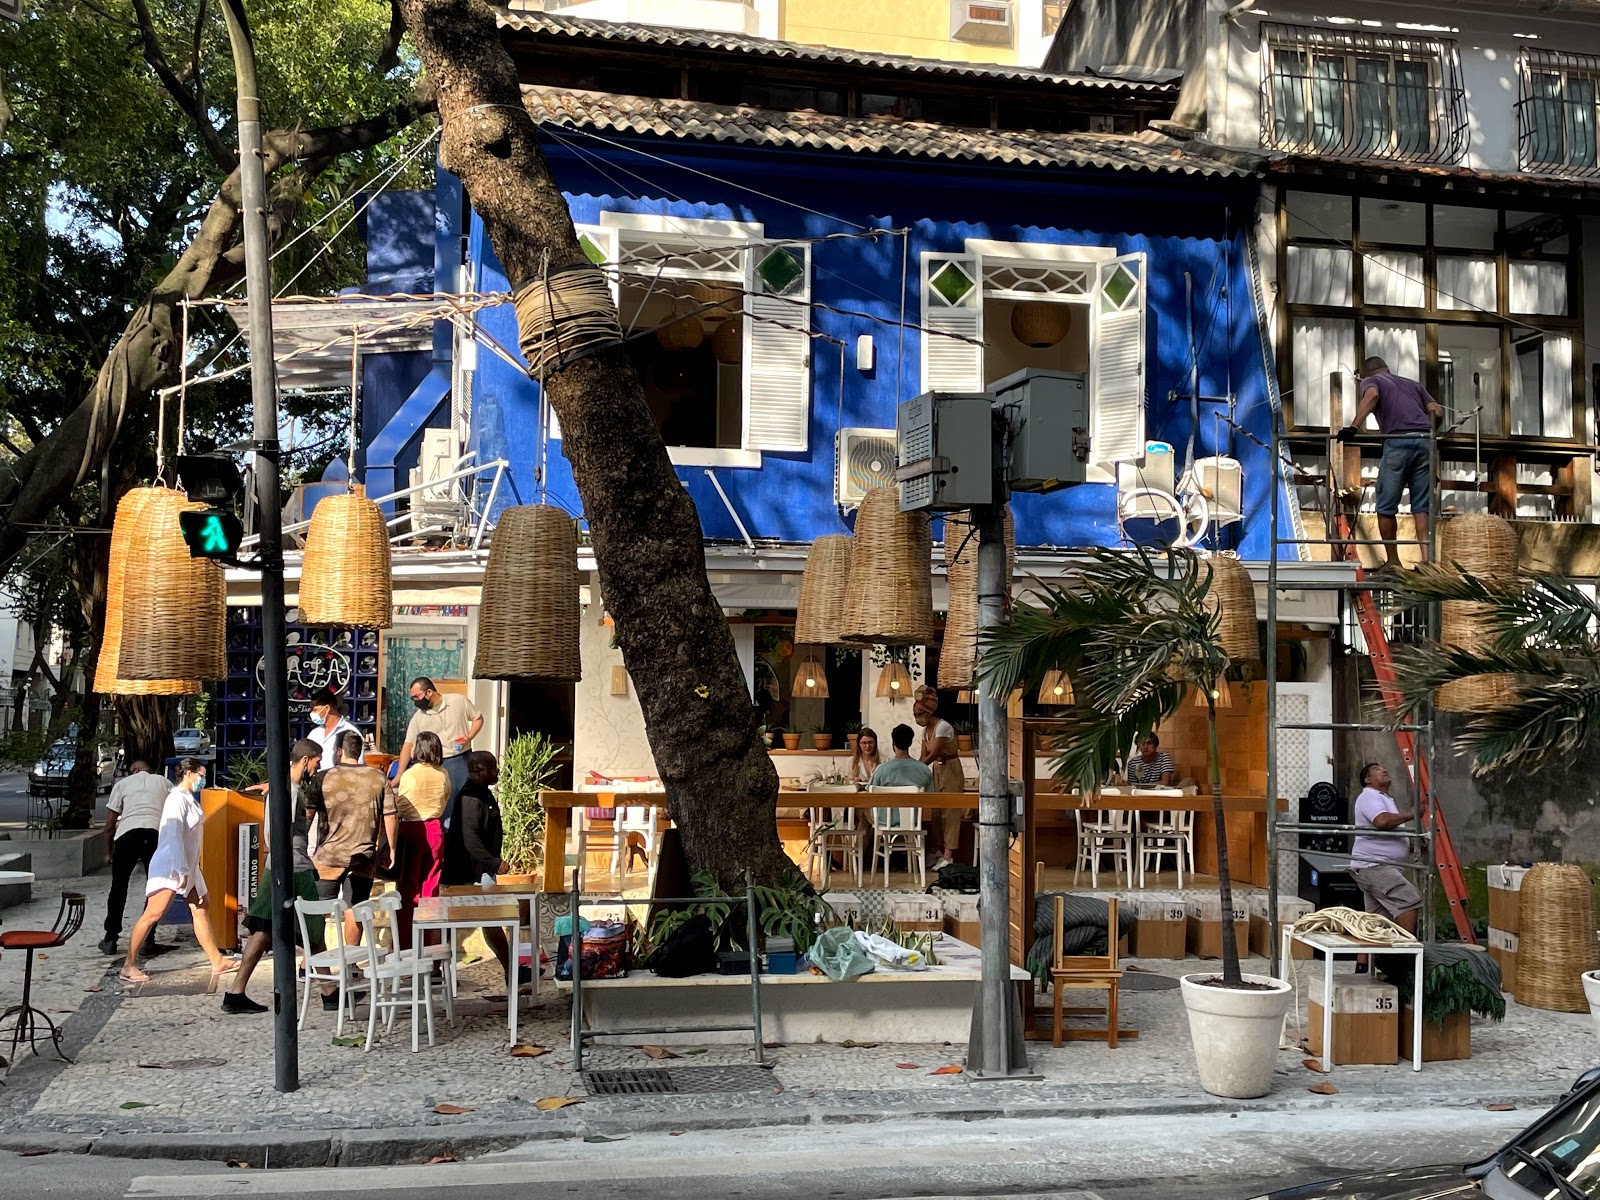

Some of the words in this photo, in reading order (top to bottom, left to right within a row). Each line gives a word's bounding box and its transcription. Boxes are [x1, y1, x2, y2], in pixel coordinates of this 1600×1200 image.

[250, 859, 258, 898] GRANADO
[926, 910, 939, 920] 34
[1170, 910, 1183, 919] 39
[1232, 910, 1245, 919] 32
[1375, 998, 1393, 1010] 35
